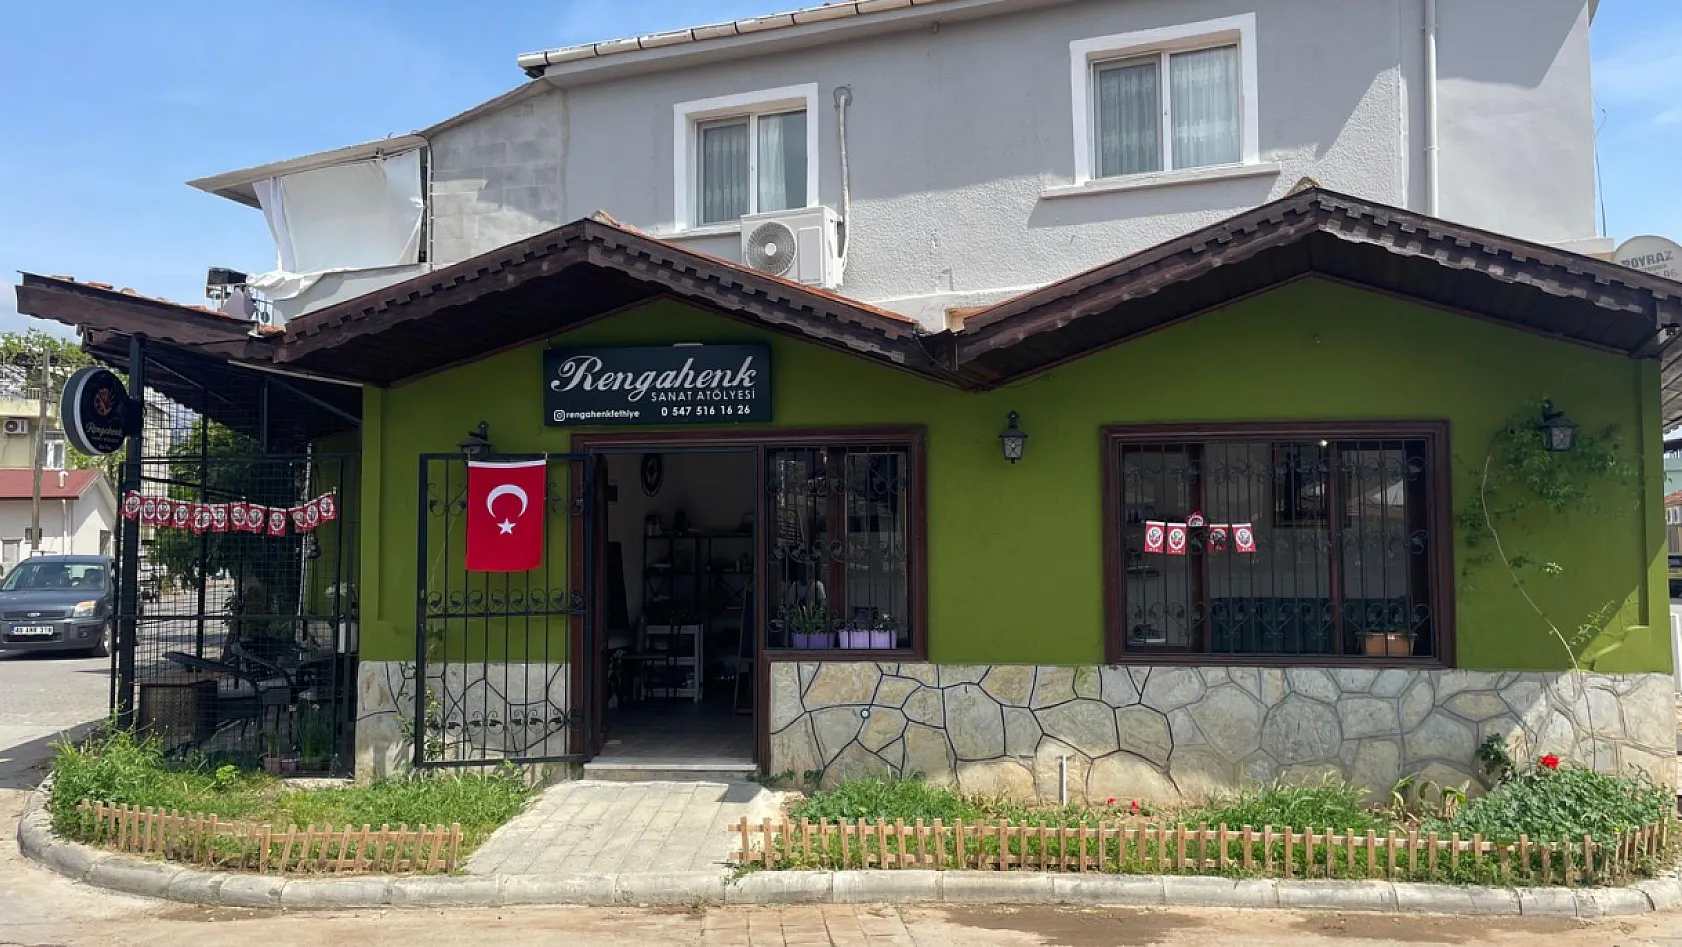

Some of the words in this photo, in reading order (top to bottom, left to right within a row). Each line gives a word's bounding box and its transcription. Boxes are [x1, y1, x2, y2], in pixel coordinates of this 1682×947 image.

[551, 355, 757, 402] Rengahenk
[651, 391, 692, 402] SANAT
[697, 388, 755, 401] ATÖLYESİ
[661, 407, 668, 417] 0
[672, 406, 692, 416] 547
[696, 405, 715, 415] 516
[721, 405, 733, 415] 16
[737, 404, 751, 415] 26
